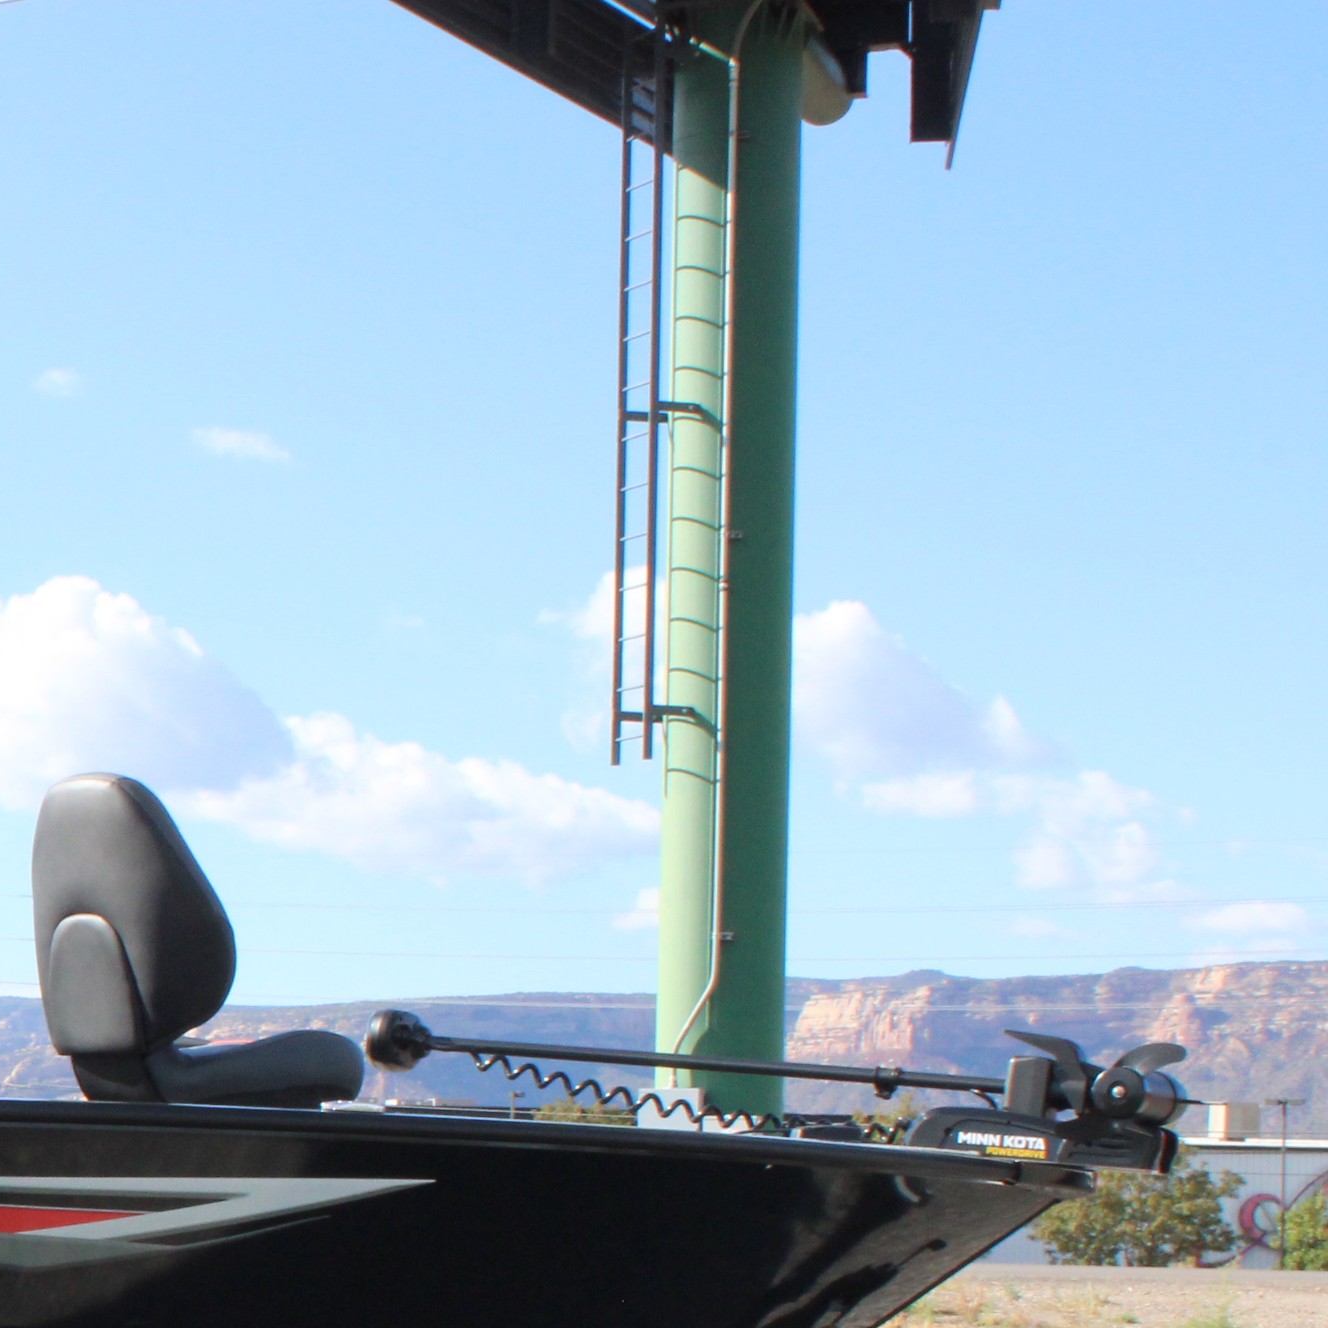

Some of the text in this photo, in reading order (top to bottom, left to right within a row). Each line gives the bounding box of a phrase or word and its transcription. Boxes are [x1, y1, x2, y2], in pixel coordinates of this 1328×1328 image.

[956, 1131, 1047, 1151] MINN KOTA
[985, 1146, 1047, 1159] POWERDRIVE
